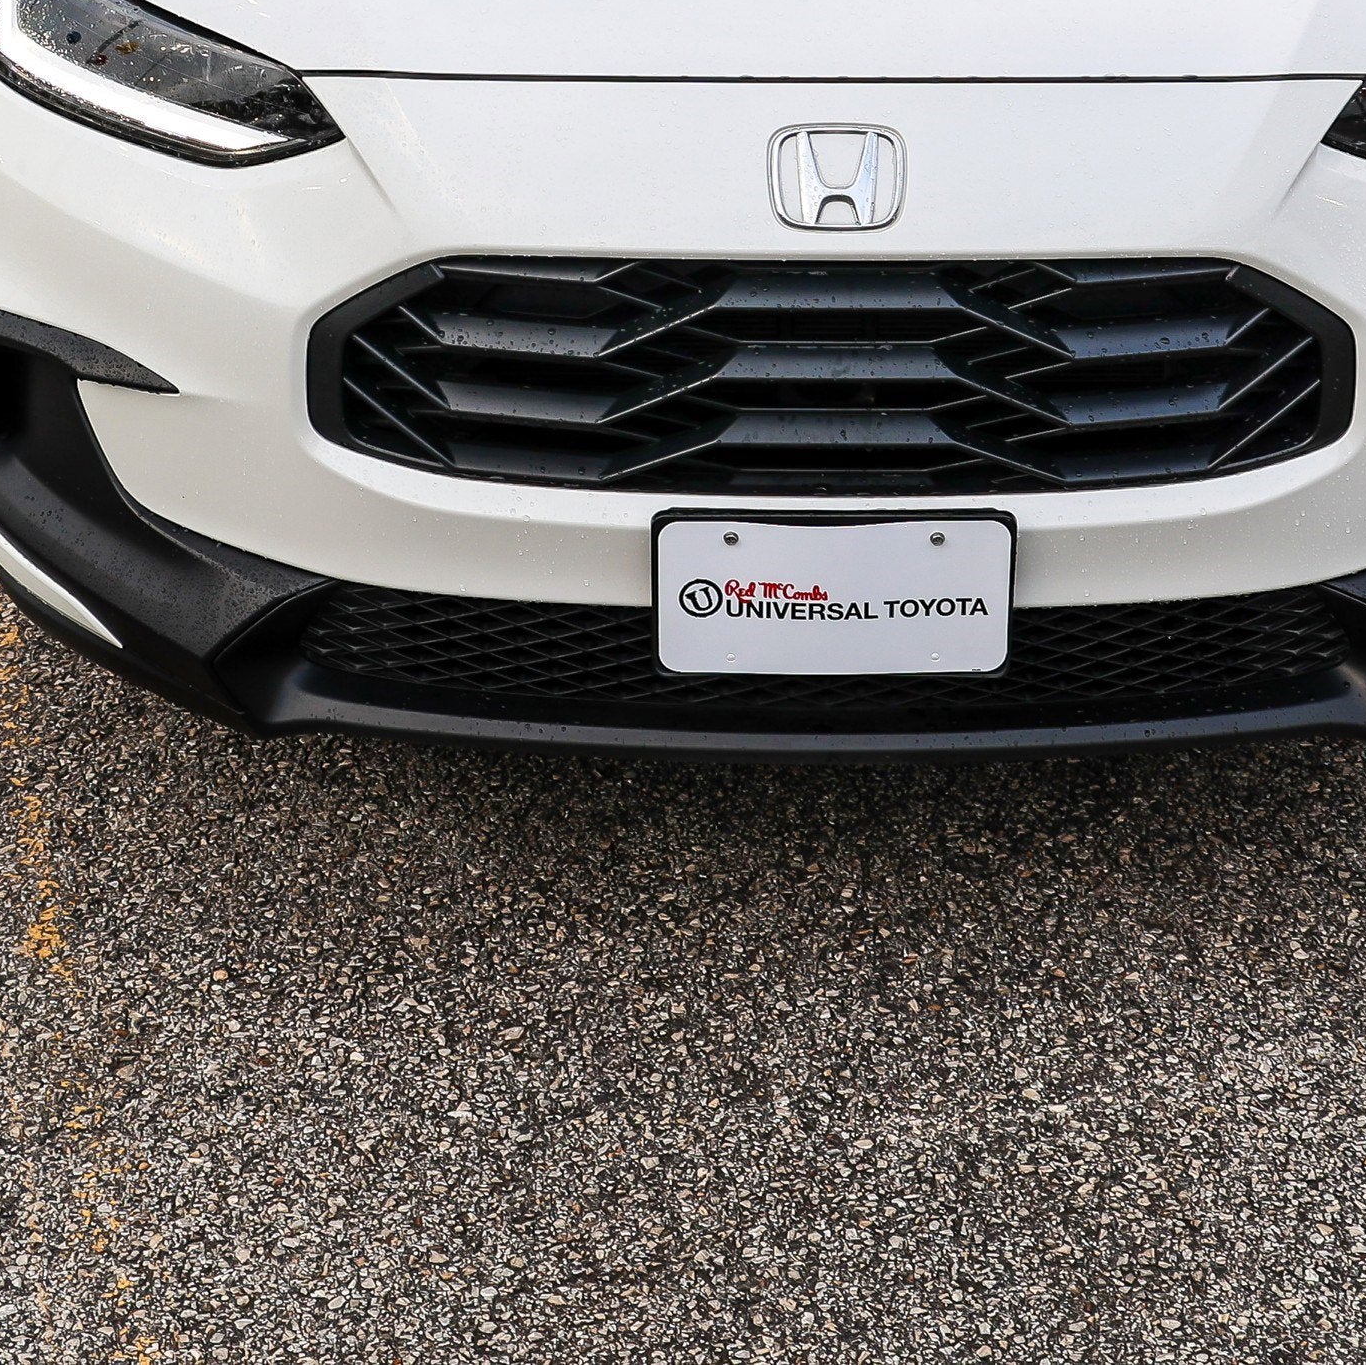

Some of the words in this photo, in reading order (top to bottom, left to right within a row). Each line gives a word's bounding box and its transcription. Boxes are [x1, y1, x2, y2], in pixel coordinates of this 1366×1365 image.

[724, 579, 756, 603] Red
[758, 582, 828, 601] McCombs
[726, 600, 878, 620] UNIVERSAL
[884, 598, 989, 618] TOYOTA
